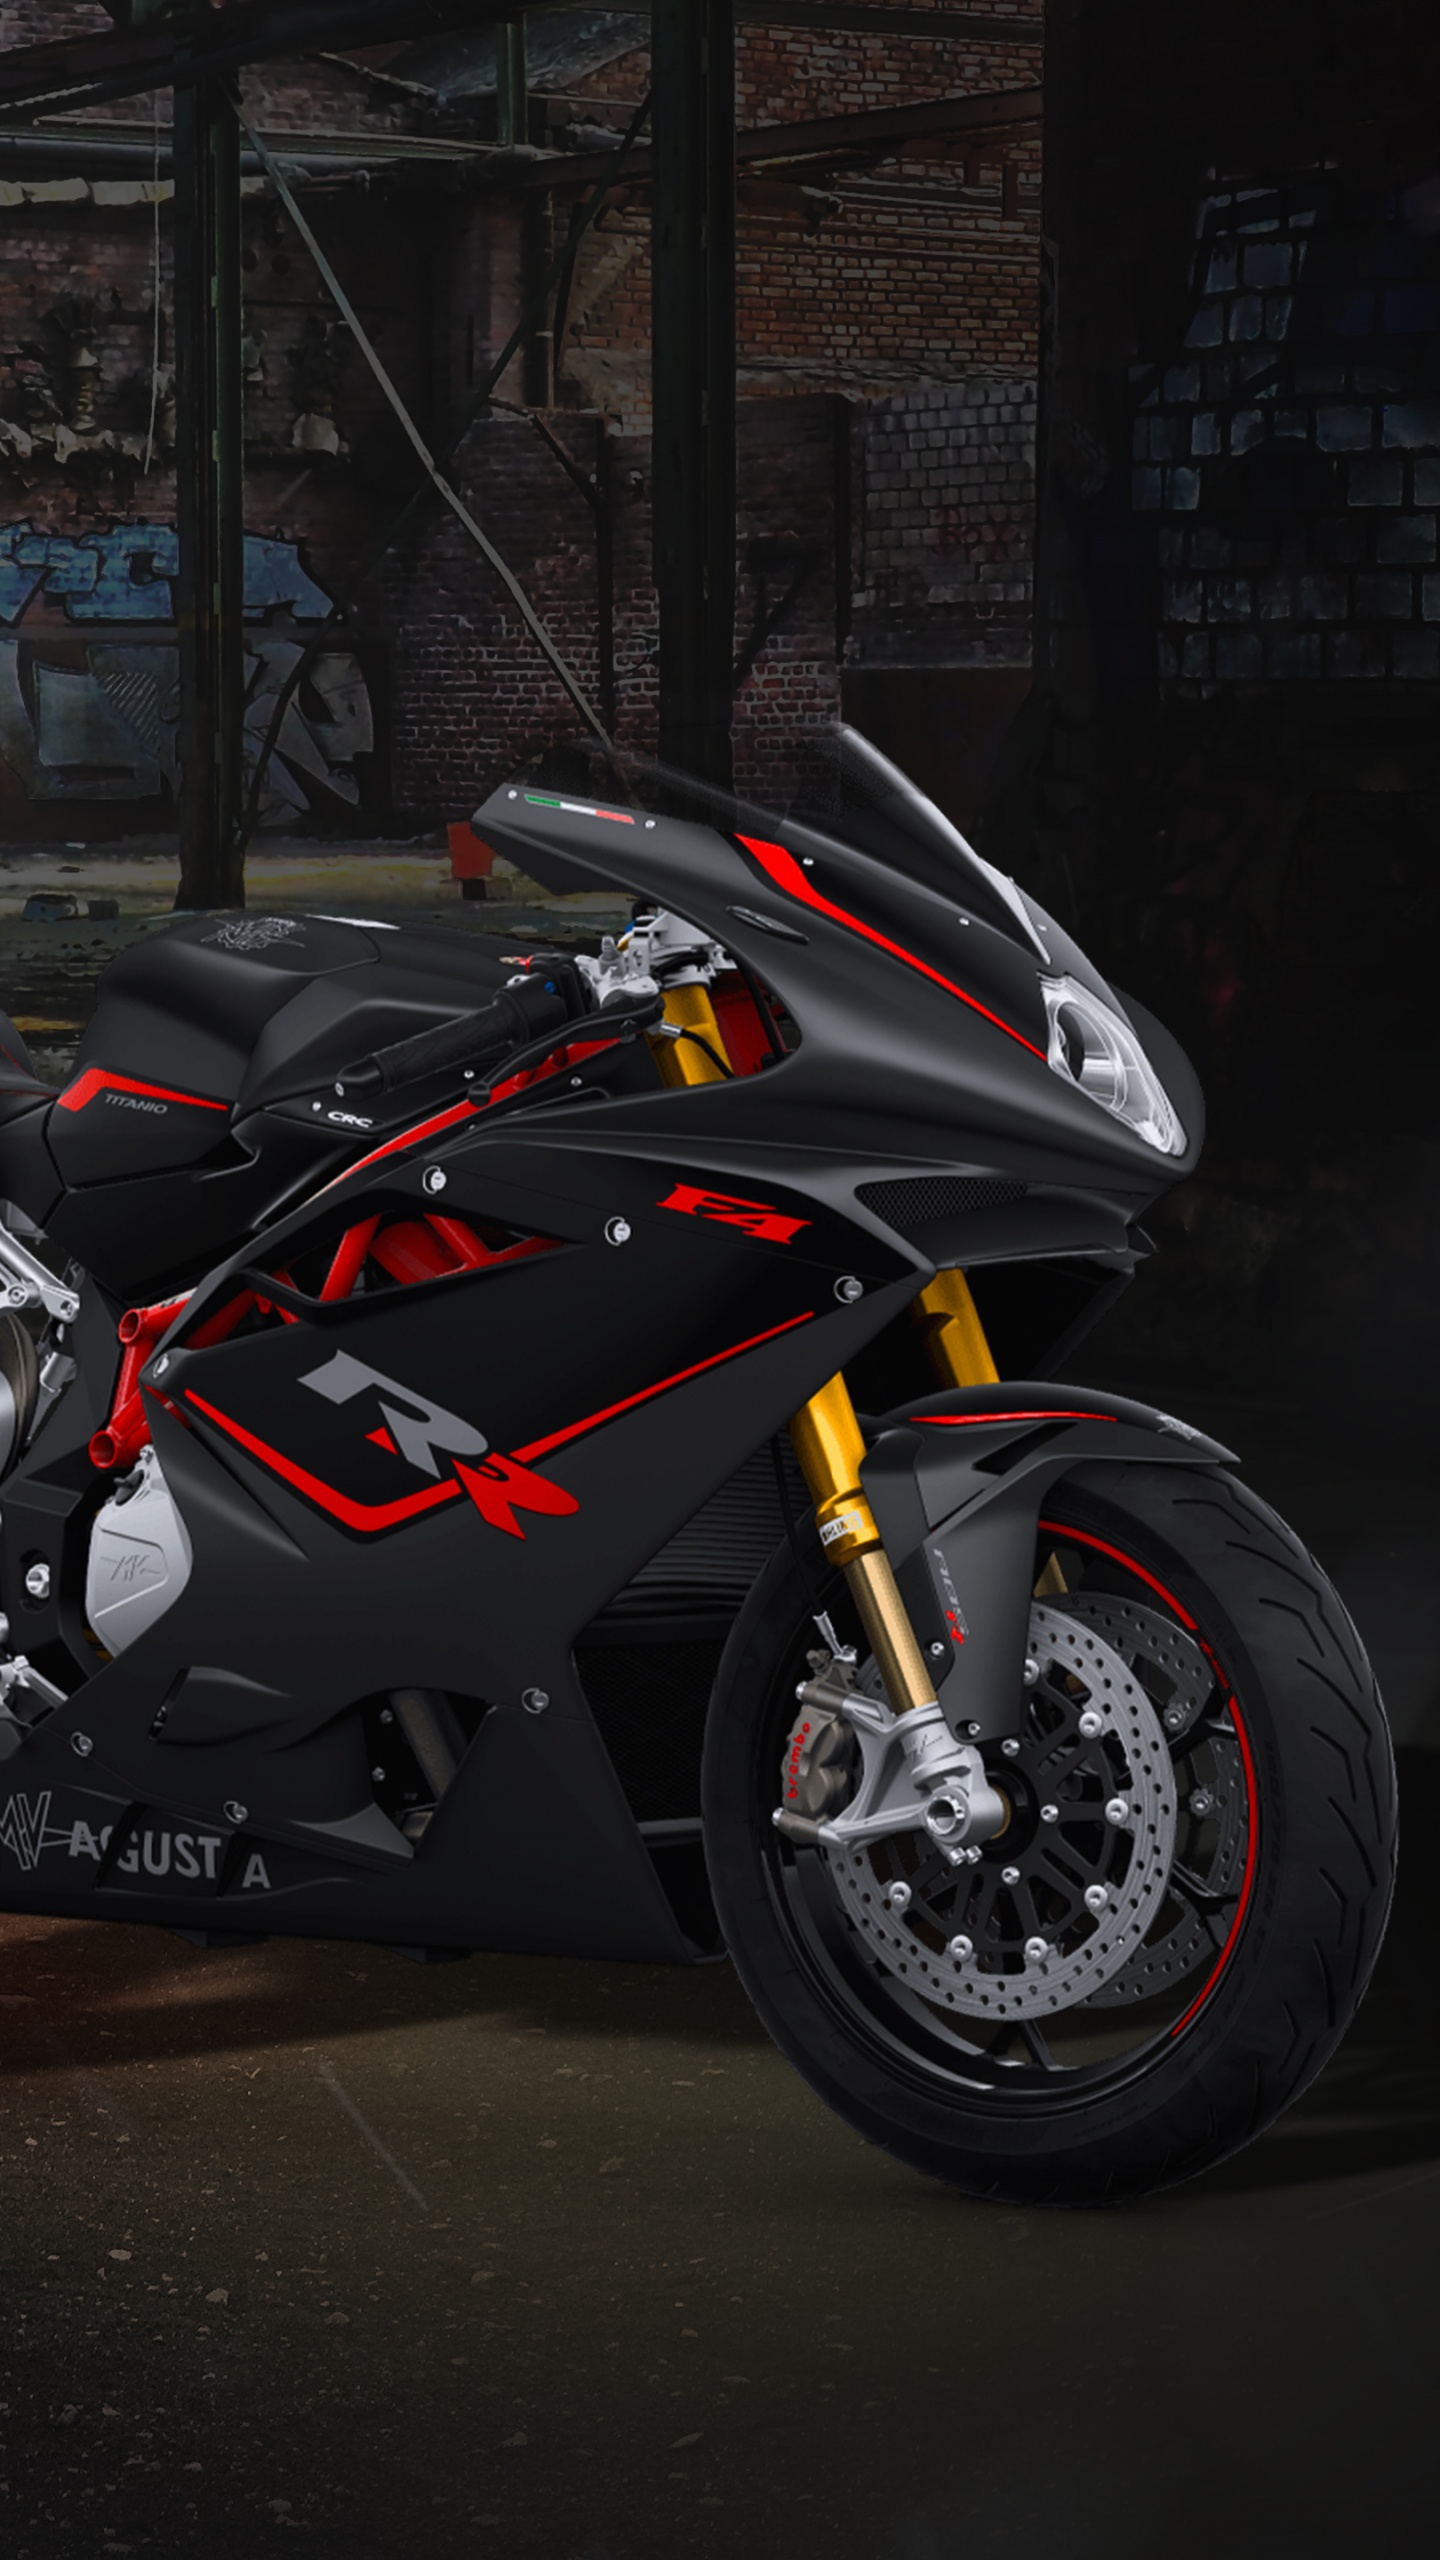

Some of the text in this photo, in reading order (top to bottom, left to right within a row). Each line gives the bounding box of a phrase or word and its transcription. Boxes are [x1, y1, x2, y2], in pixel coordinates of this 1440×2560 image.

[104, 1093, 169, 1115] TITANIO
[327, 1110, 374, 1129] CRC
[655, 1182, 814, 1245] F4
[786, 1721, 811, 1799] brembo
[67, 1819, 273, 1890] AGUSTA
